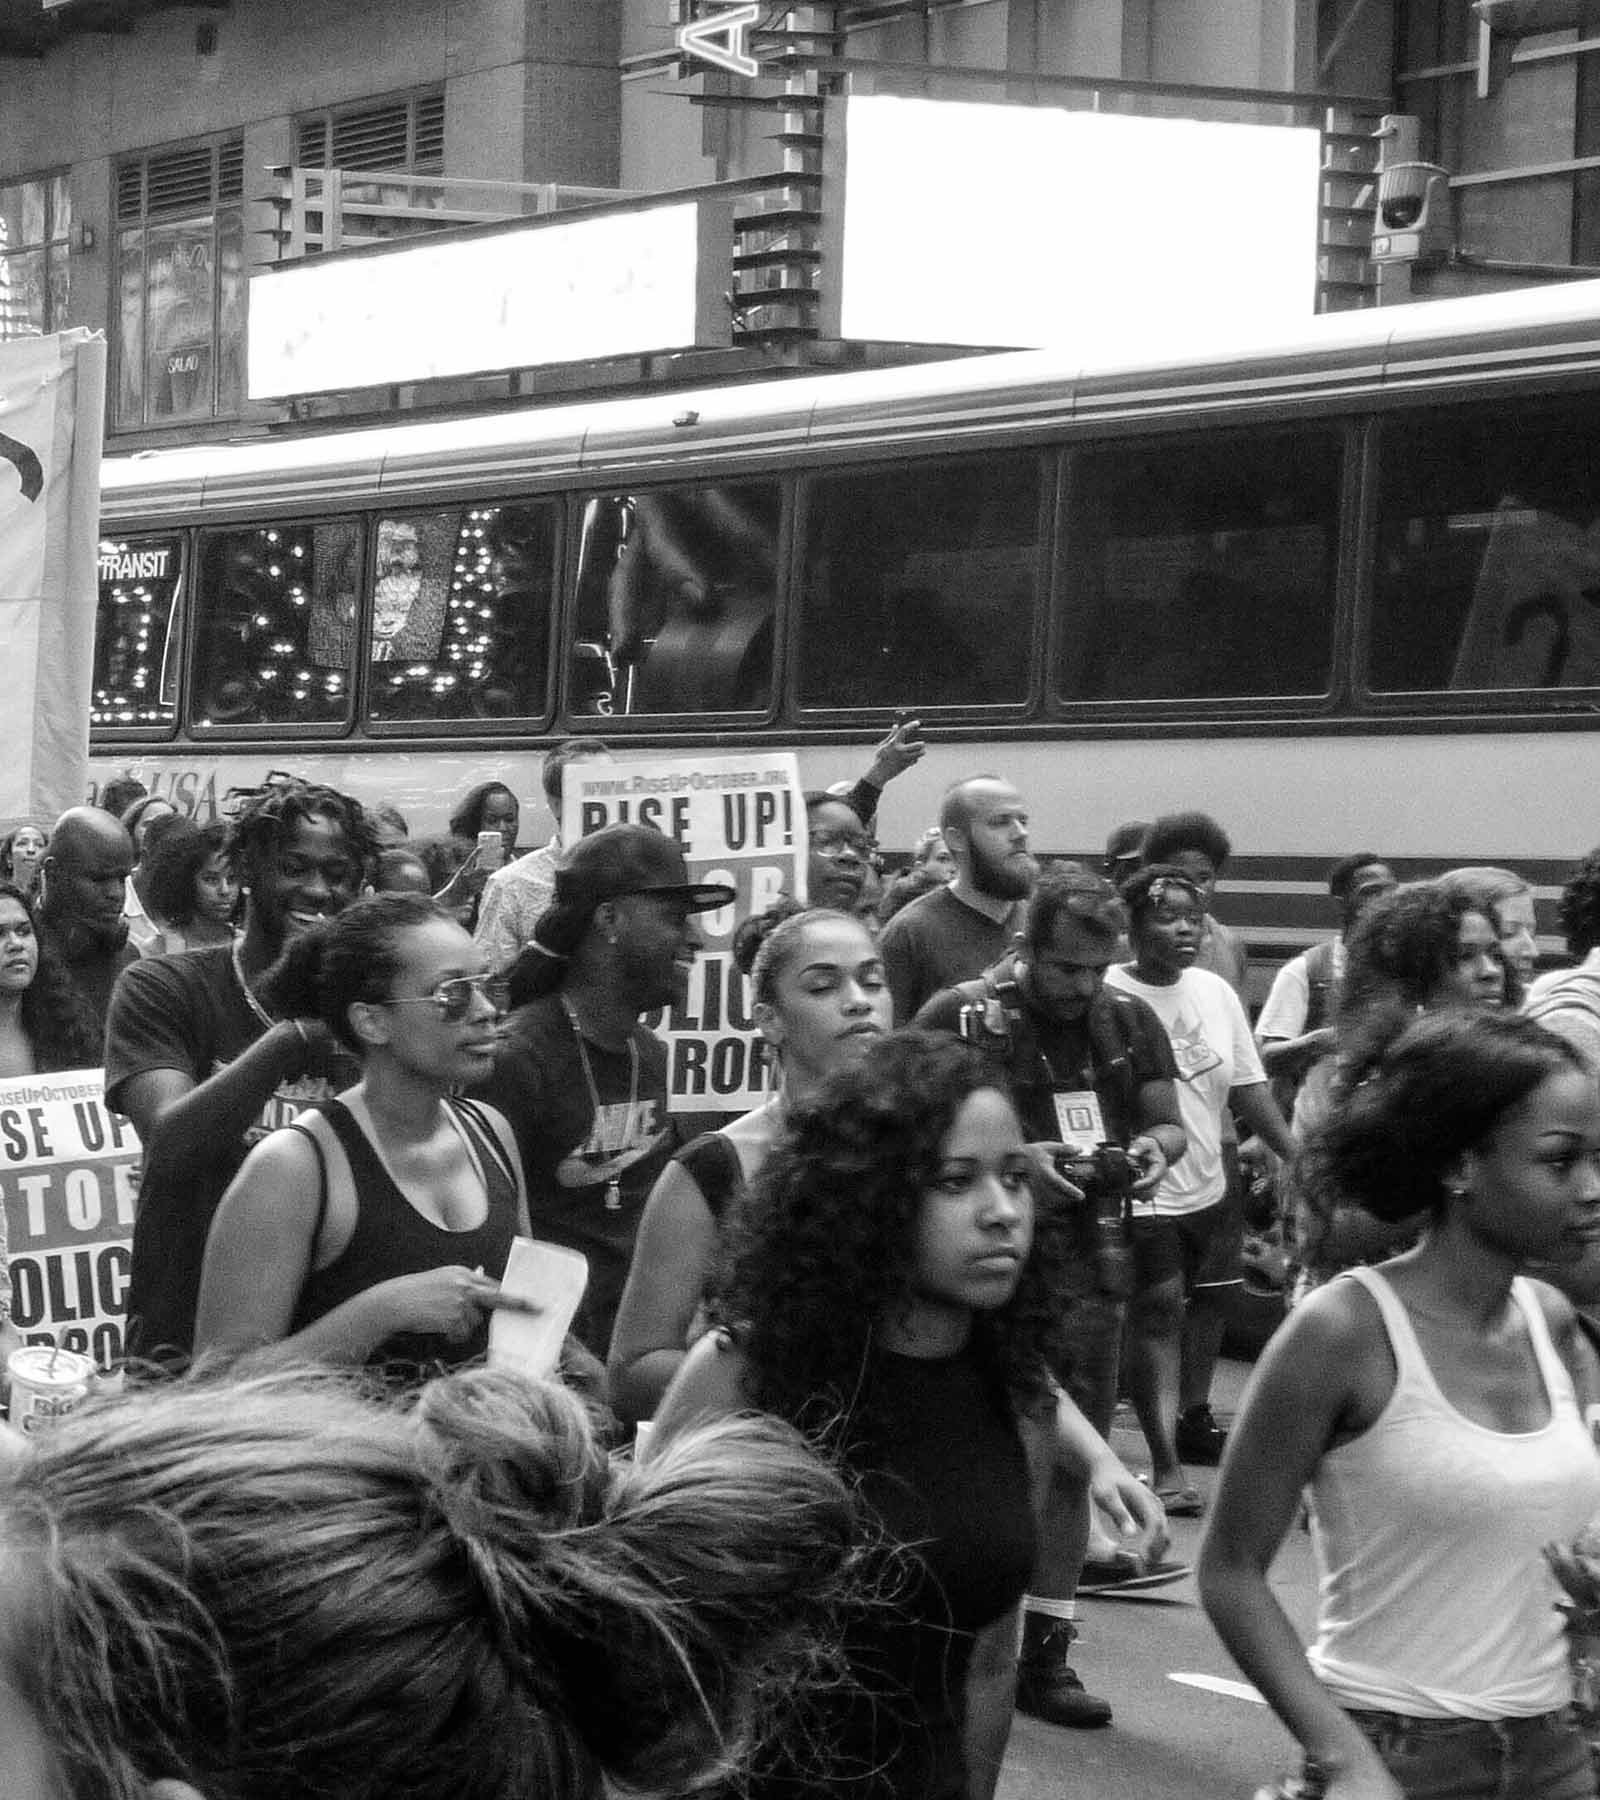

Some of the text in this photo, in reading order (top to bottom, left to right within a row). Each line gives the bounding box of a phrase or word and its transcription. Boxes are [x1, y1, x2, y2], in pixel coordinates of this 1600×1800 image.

[100, 551, 169, 580] TRANSIT
[723, 790, 793, 851] UP!
[8, 1246, 133, 1329] OLIC
